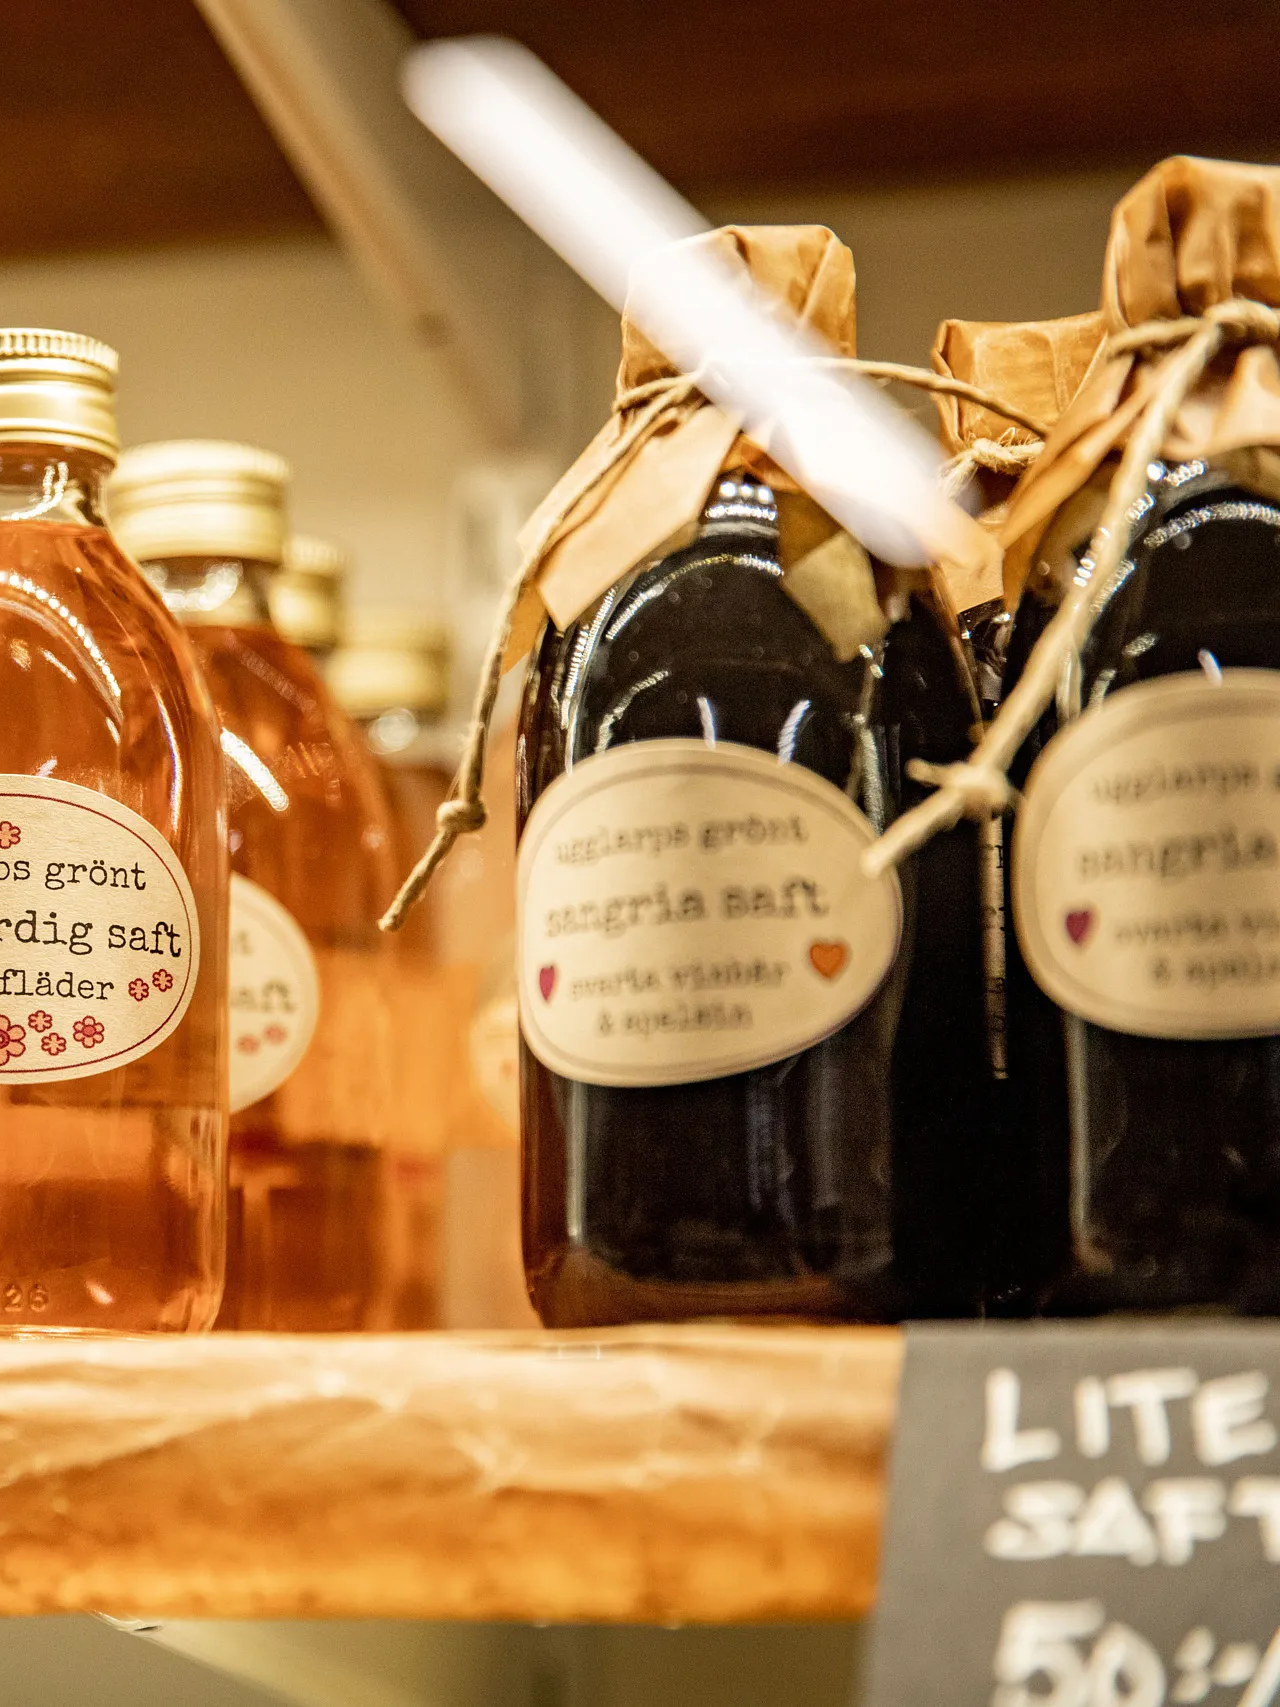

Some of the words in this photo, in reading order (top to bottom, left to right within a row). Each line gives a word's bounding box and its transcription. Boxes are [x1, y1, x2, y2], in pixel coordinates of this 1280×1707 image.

[44, 858, 147, 890] grönt
[547, 884, 707, 938] sangria
[723, 876, 829, 918] saft
[108, 921, 182, 958] saft
[980, 1367, 1278, 1473] LITE
[983, 1475, 1280, 1567] SAFT
